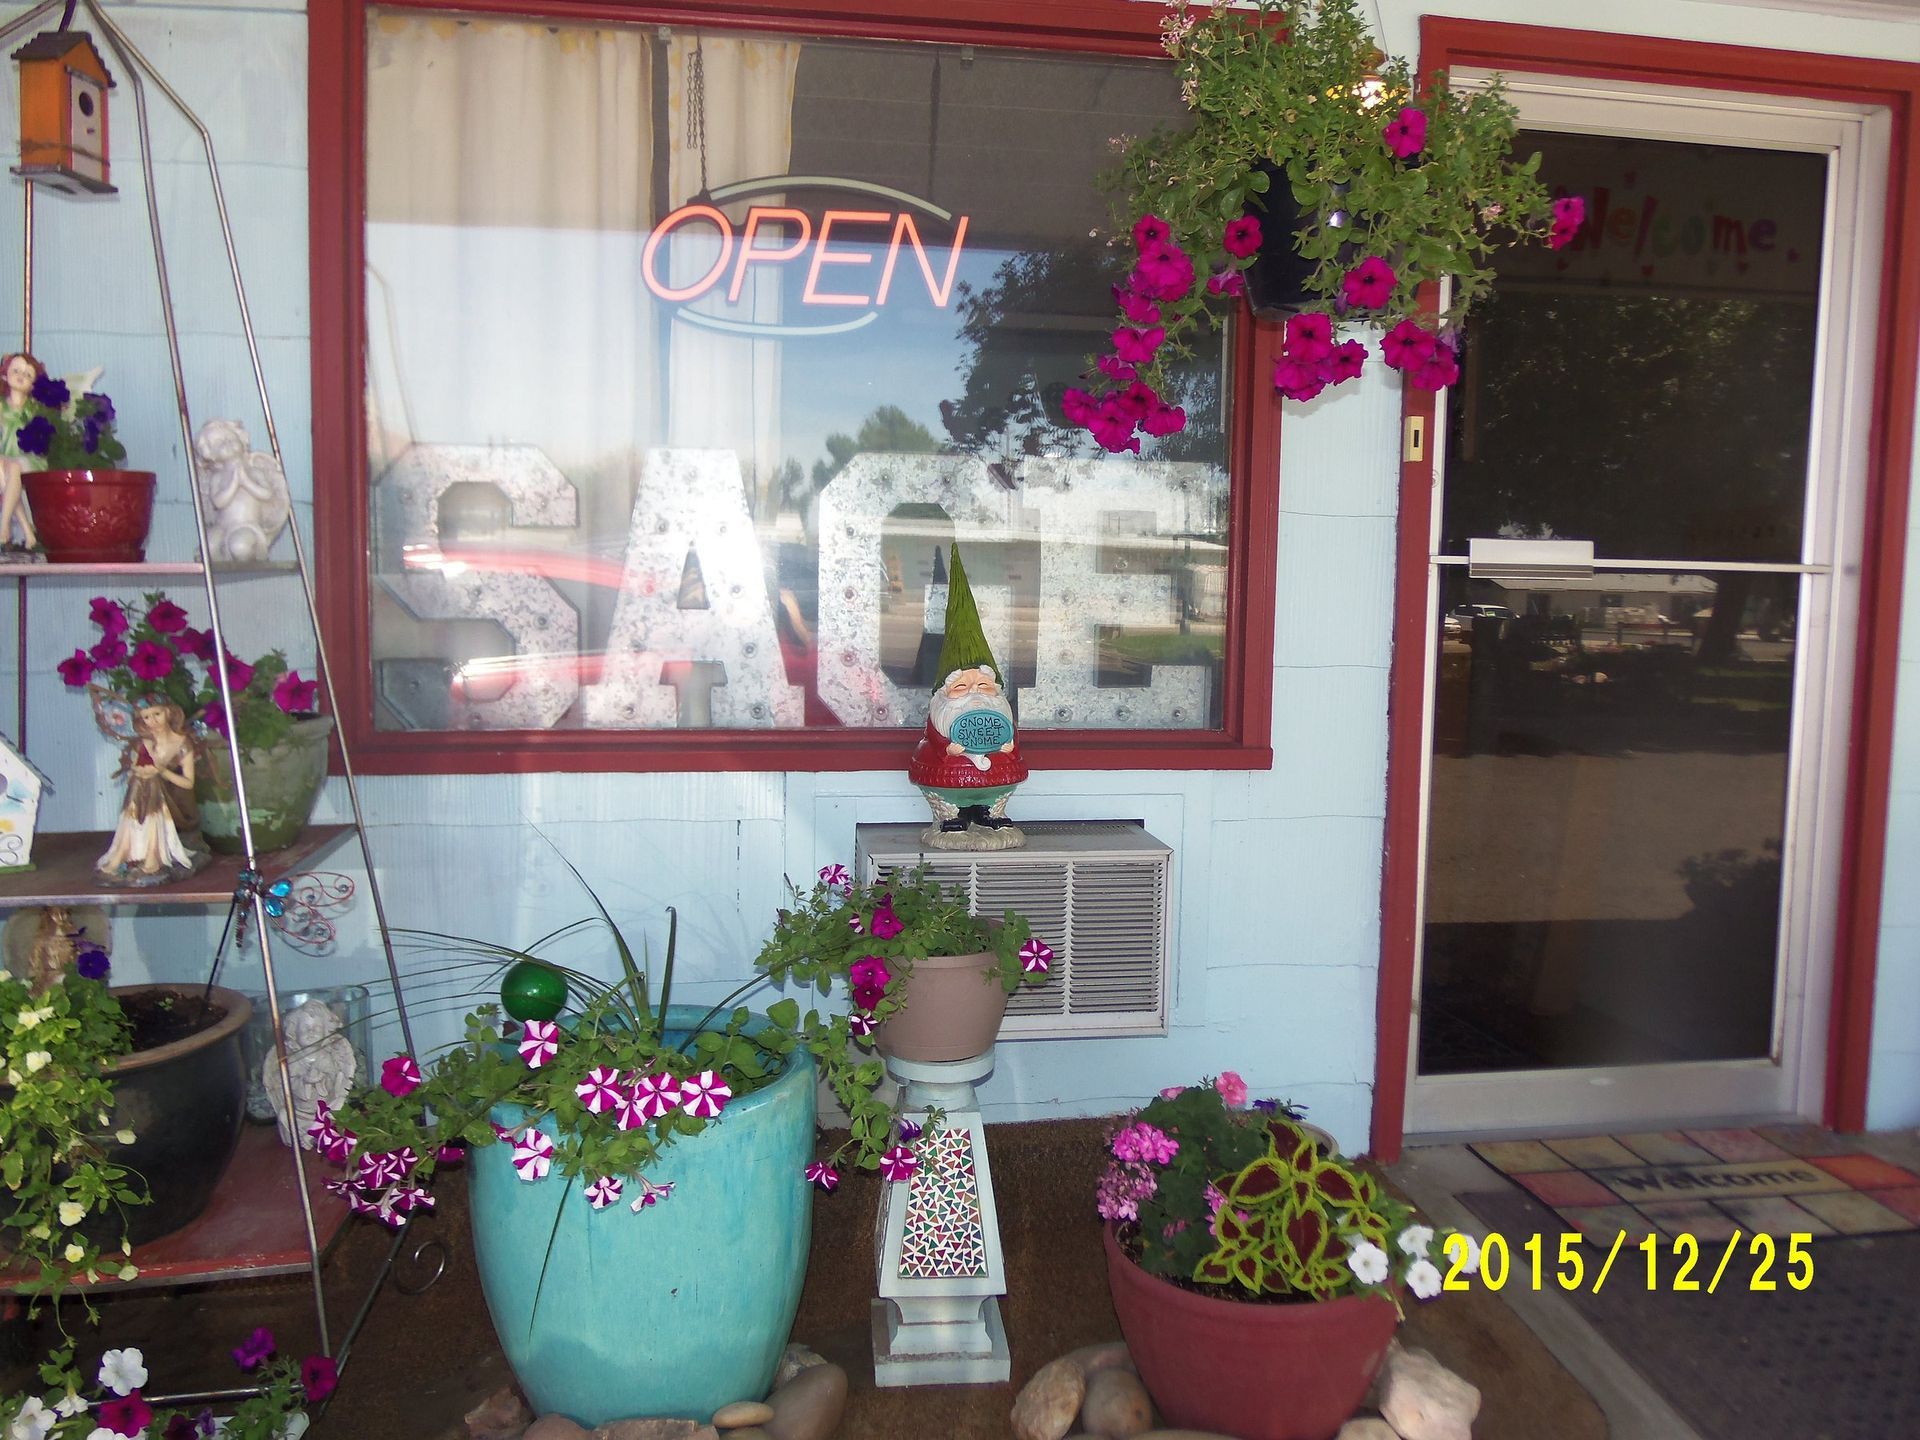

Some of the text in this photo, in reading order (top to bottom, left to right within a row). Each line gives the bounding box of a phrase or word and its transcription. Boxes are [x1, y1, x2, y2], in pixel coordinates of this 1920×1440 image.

[641, 203, 969, 307] OPEN
[374, 442, 1212, 728] SAGE
[960, 716, 1002, 728] GNOME
[958, 726, 1005, 740] SWEET
[962, 736, 1000, 747] GNOME
[1614, 1170, 1819, 1191] Welcome
